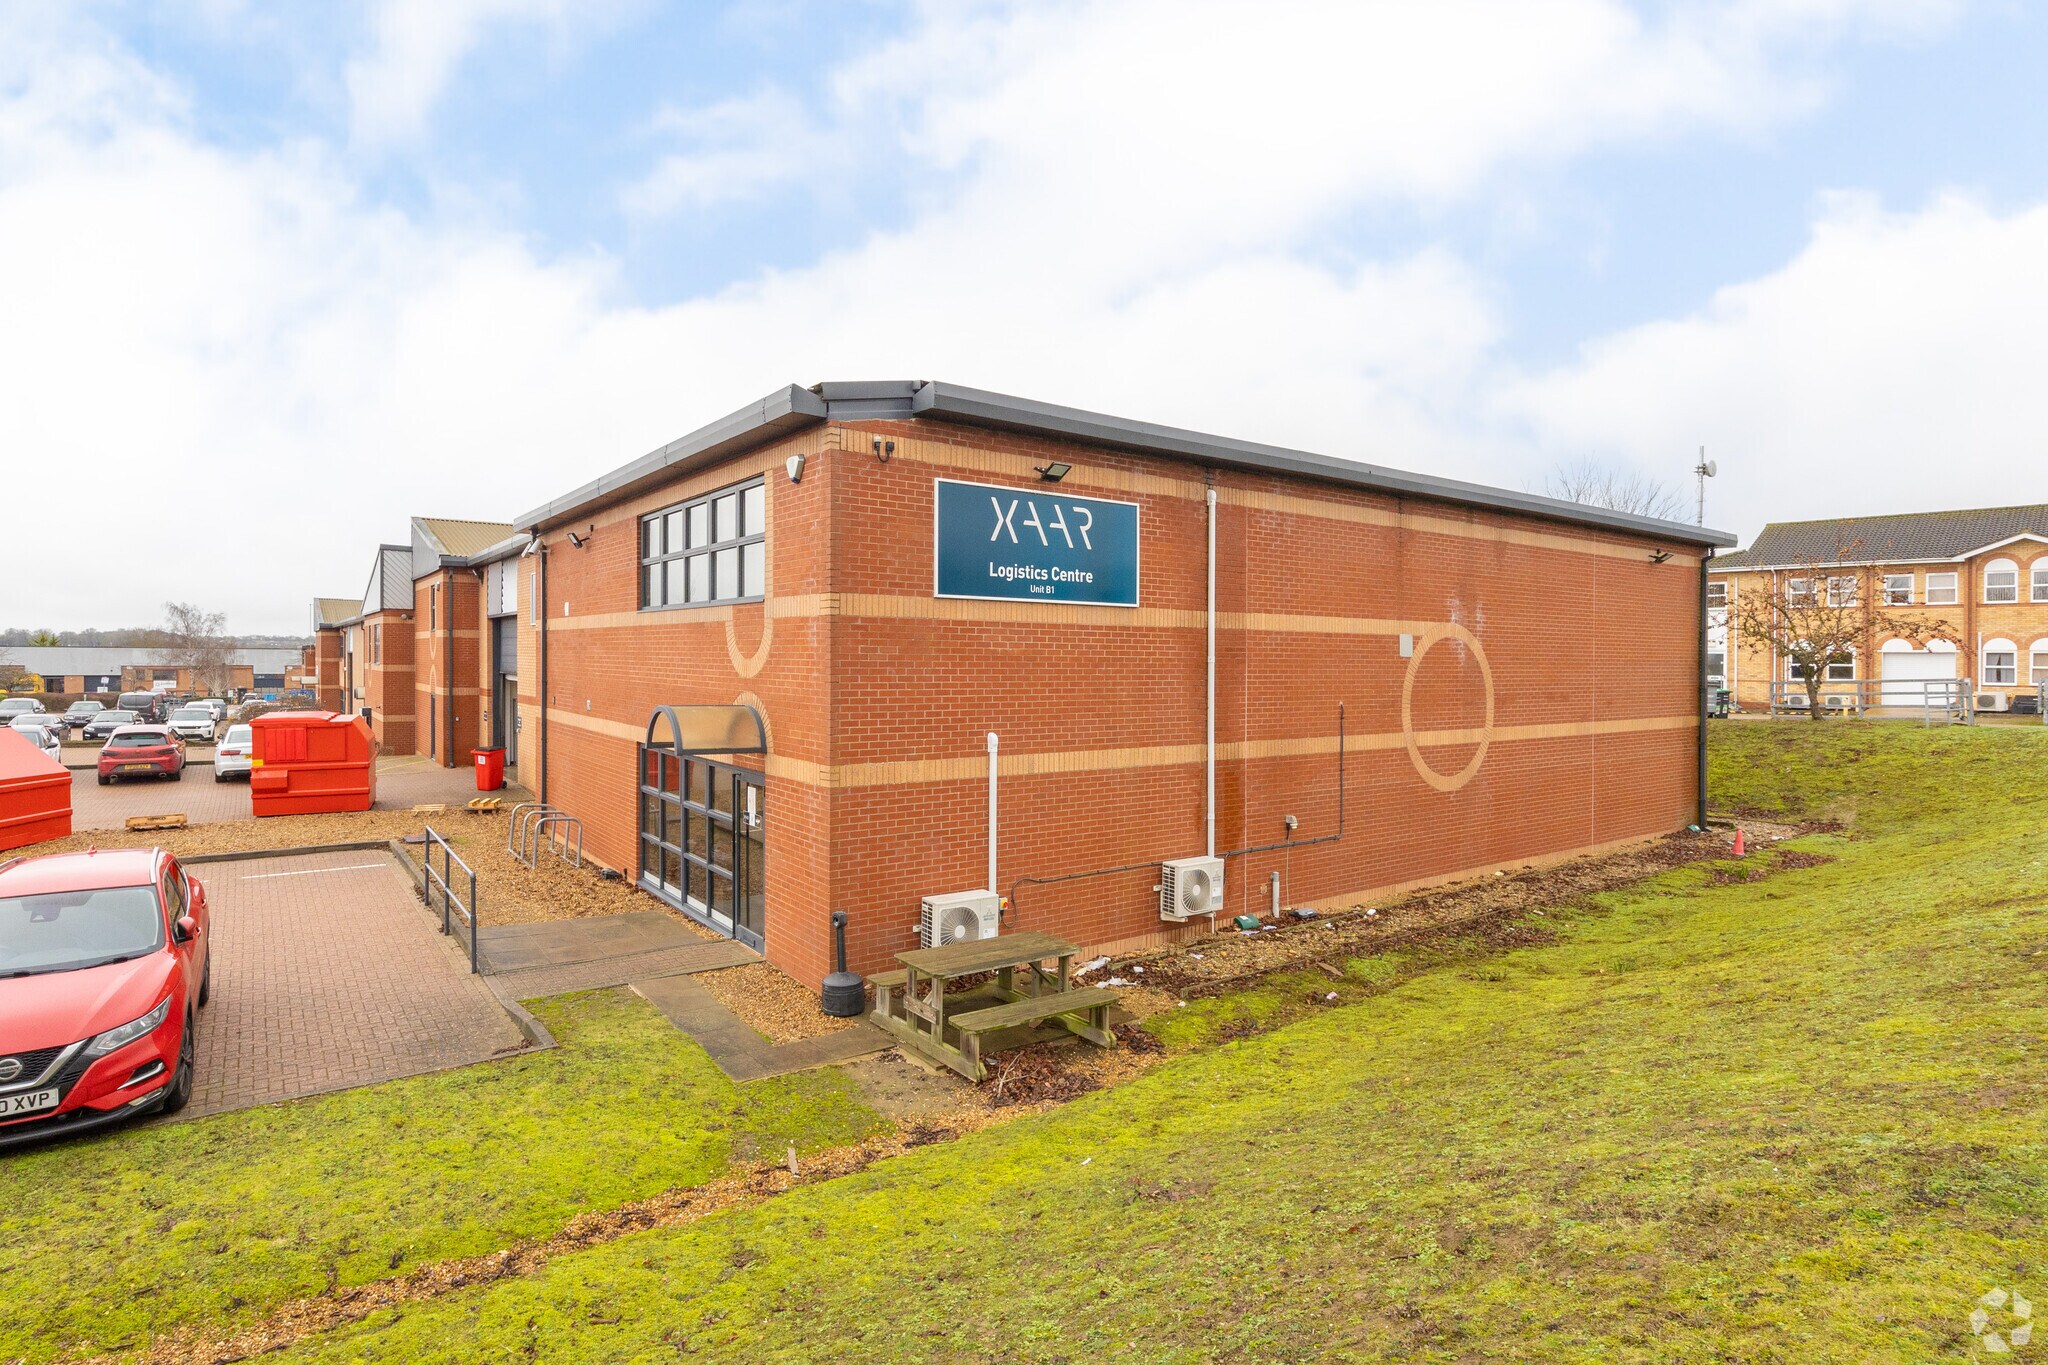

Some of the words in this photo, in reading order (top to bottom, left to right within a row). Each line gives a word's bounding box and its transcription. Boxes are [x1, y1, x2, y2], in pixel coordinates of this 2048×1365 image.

[991, 496, 1093, 550] XAAR
[990, 562, 1048, 581] Logistics
[1051, 567, 1093, 583] Centre
[1030, 584, 1044, 594] Unit
[1045, 586, 1055, 594] B1
[14, 1092, 49, 1110] XVP
